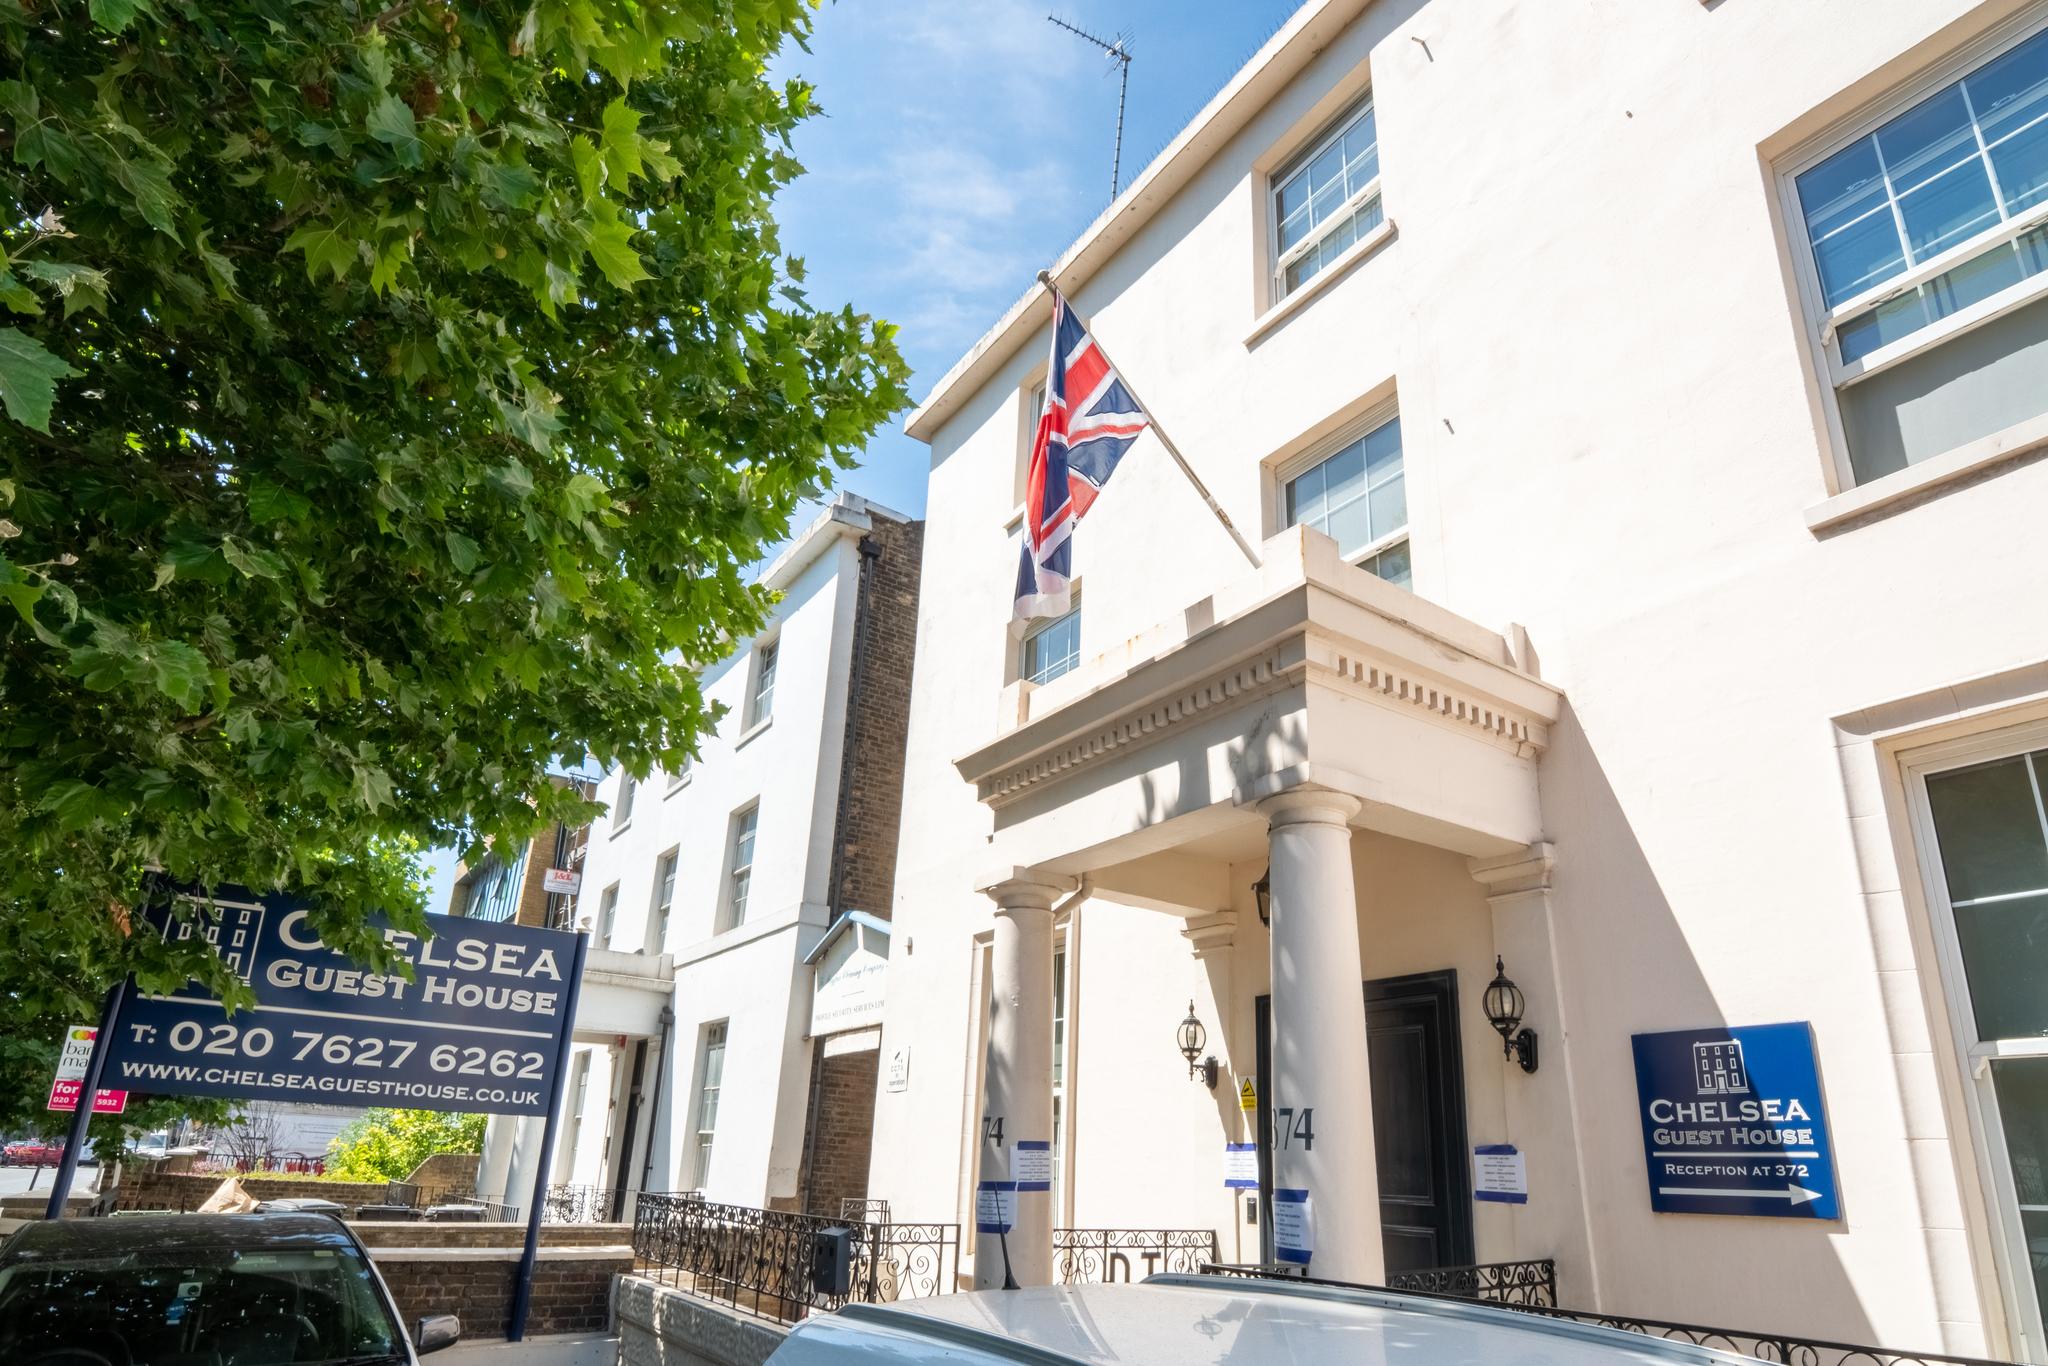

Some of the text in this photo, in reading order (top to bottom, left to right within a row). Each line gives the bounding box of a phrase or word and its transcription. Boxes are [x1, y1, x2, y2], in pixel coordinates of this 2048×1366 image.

[278, 910, 563, 981] CELSEA
[266, 958, 558, 1016] GUEST HOUSE
[66, 1041, 93, 1056] bar
[130, 1020, 545, 1081] T: 020 7627 6262
[63, 1057, 88, 1068] ma
[56, 1083, 79, 1094] for
[121, 1061, 540, 1105] WWW.CHELSEAGUESTHOUSE.CO.UK
[53, 1096, 69, 1104] 020
[96, 1098, 118, 1106] 5932
[1650, 1098, 1811, 1124] CHELSEA
[1273, 1108, 1315, 1151] 74
[1653, 1127, 1814, 1146] GUEST HOUSE
[1665, 1163, 1809, 1177] RECEPTION AT 372
